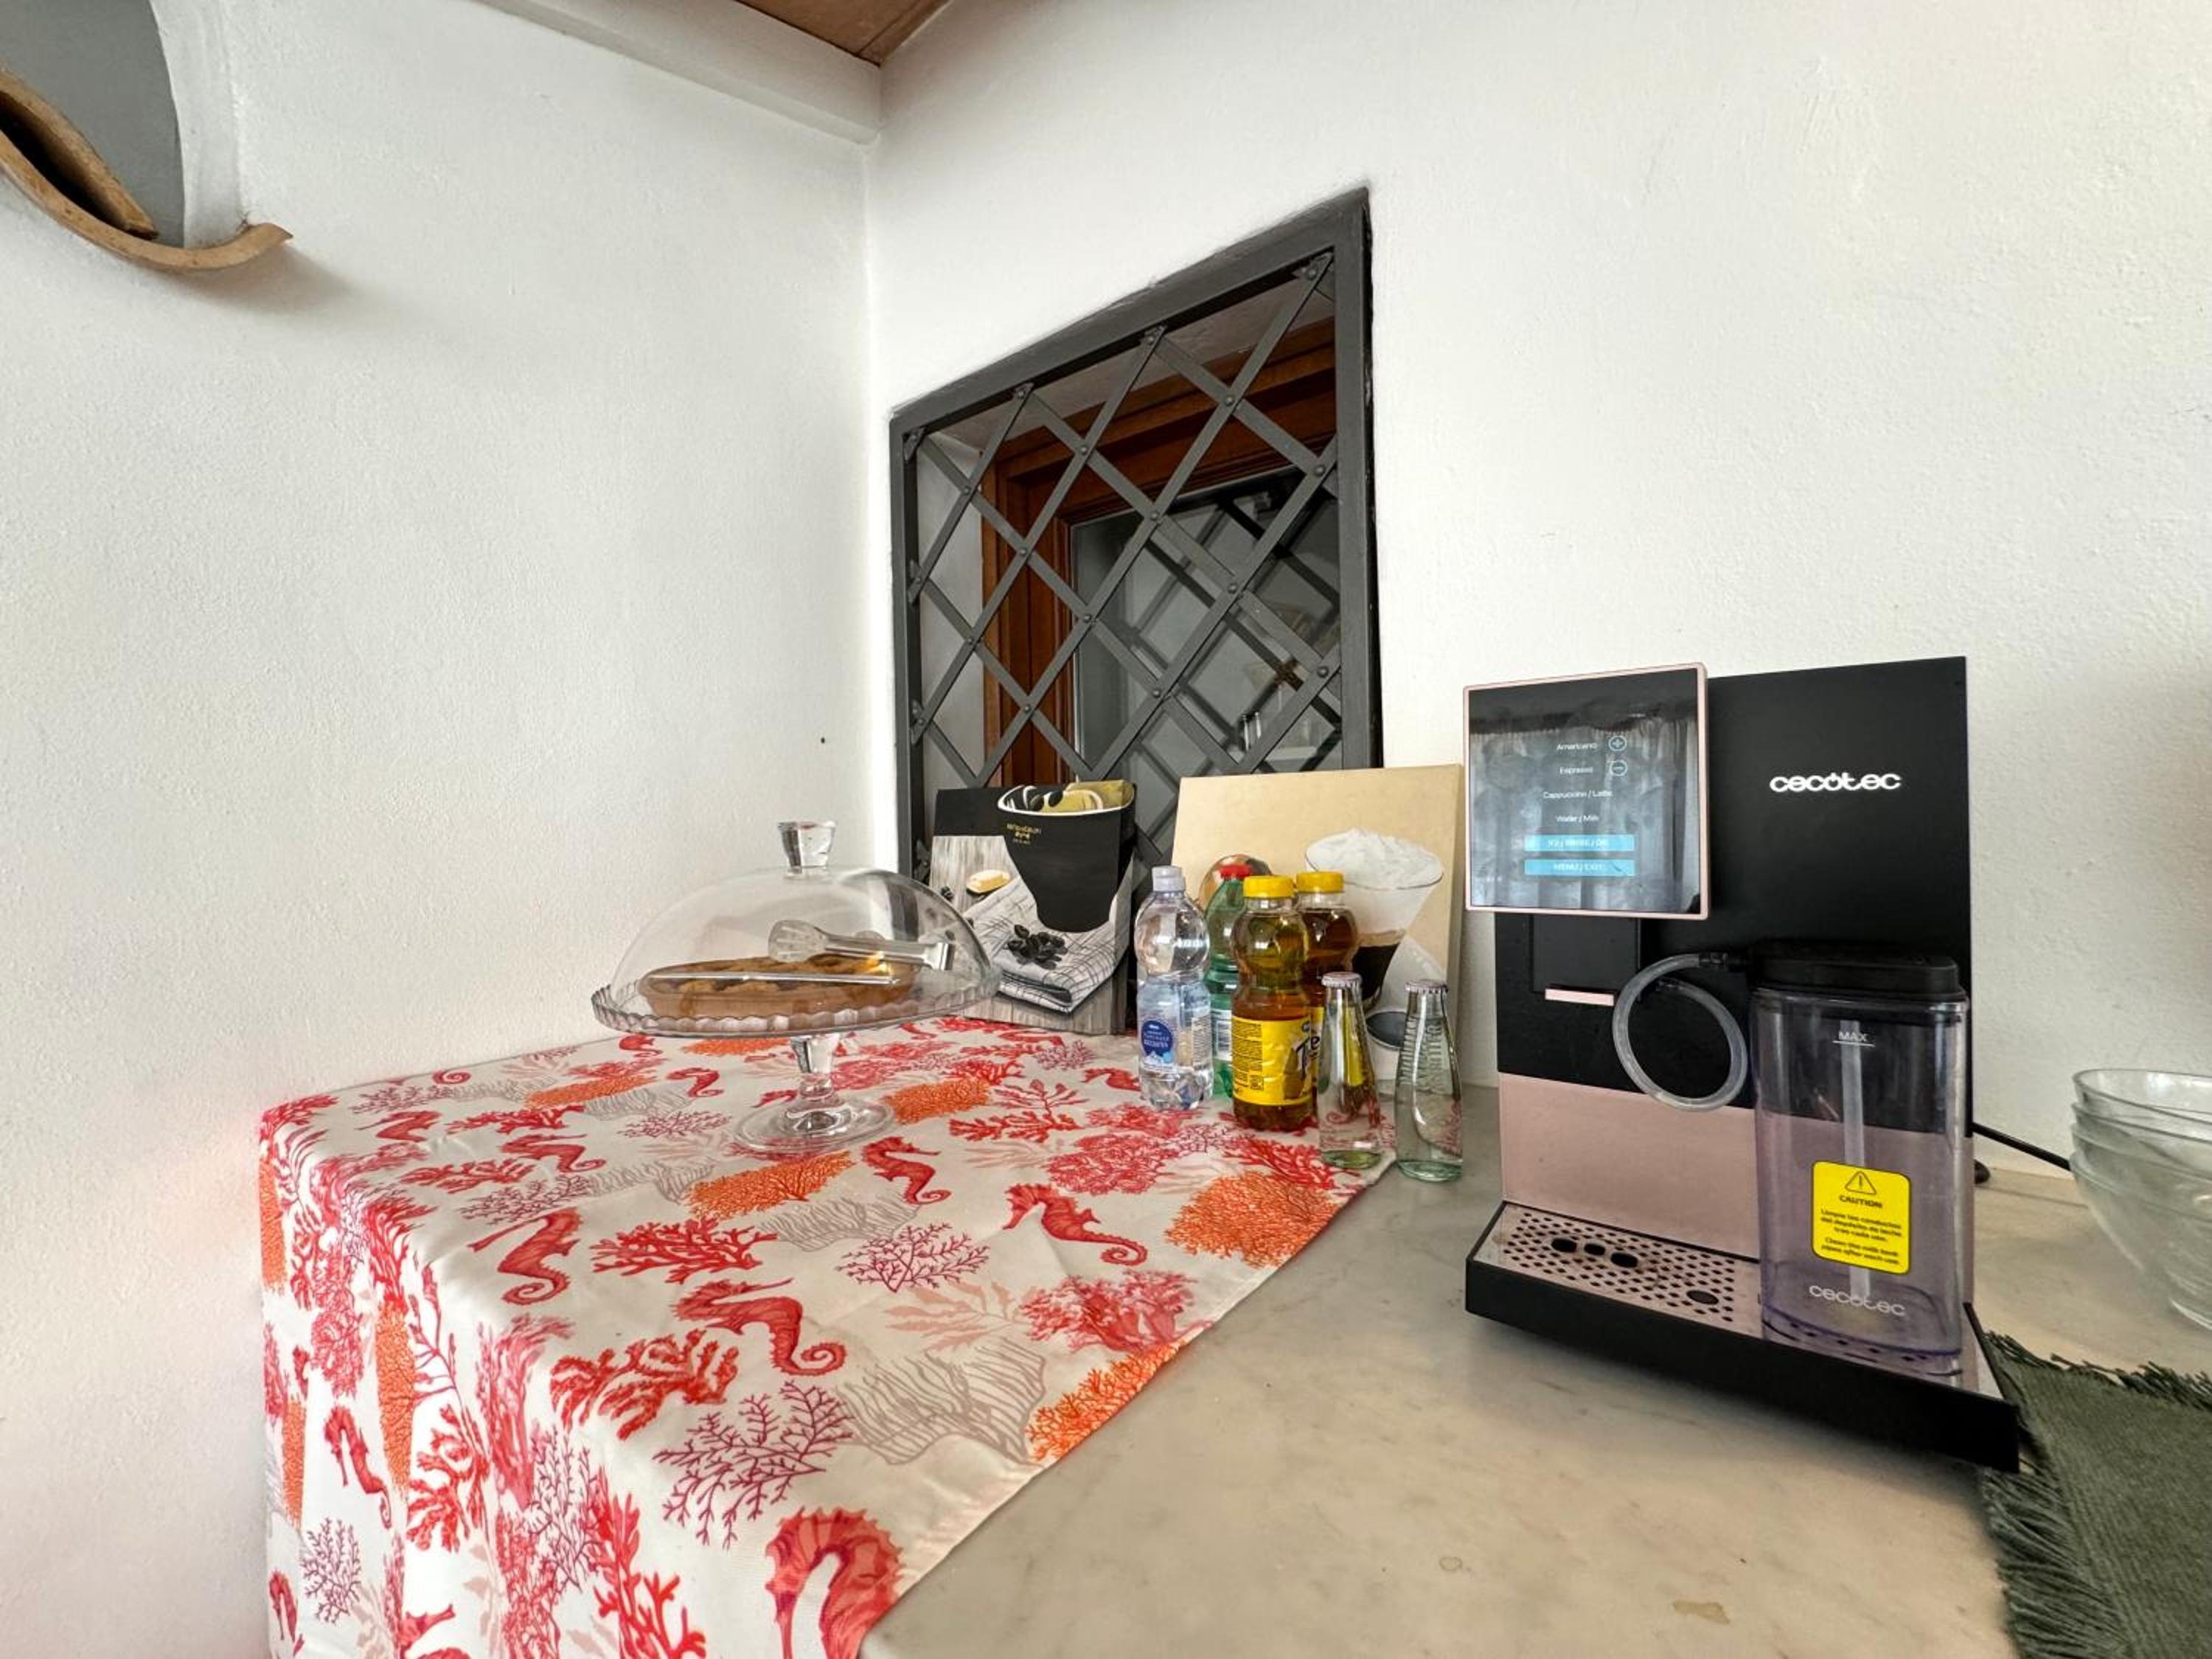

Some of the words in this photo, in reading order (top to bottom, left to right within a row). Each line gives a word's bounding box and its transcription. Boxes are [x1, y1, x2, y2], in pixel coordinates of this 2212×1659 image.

[1770, 773, 1901, 793] cecotec
[1838, 1031, 1867, 1042] MAX
[1839, 1194, 1882, 1208] CAUTION
